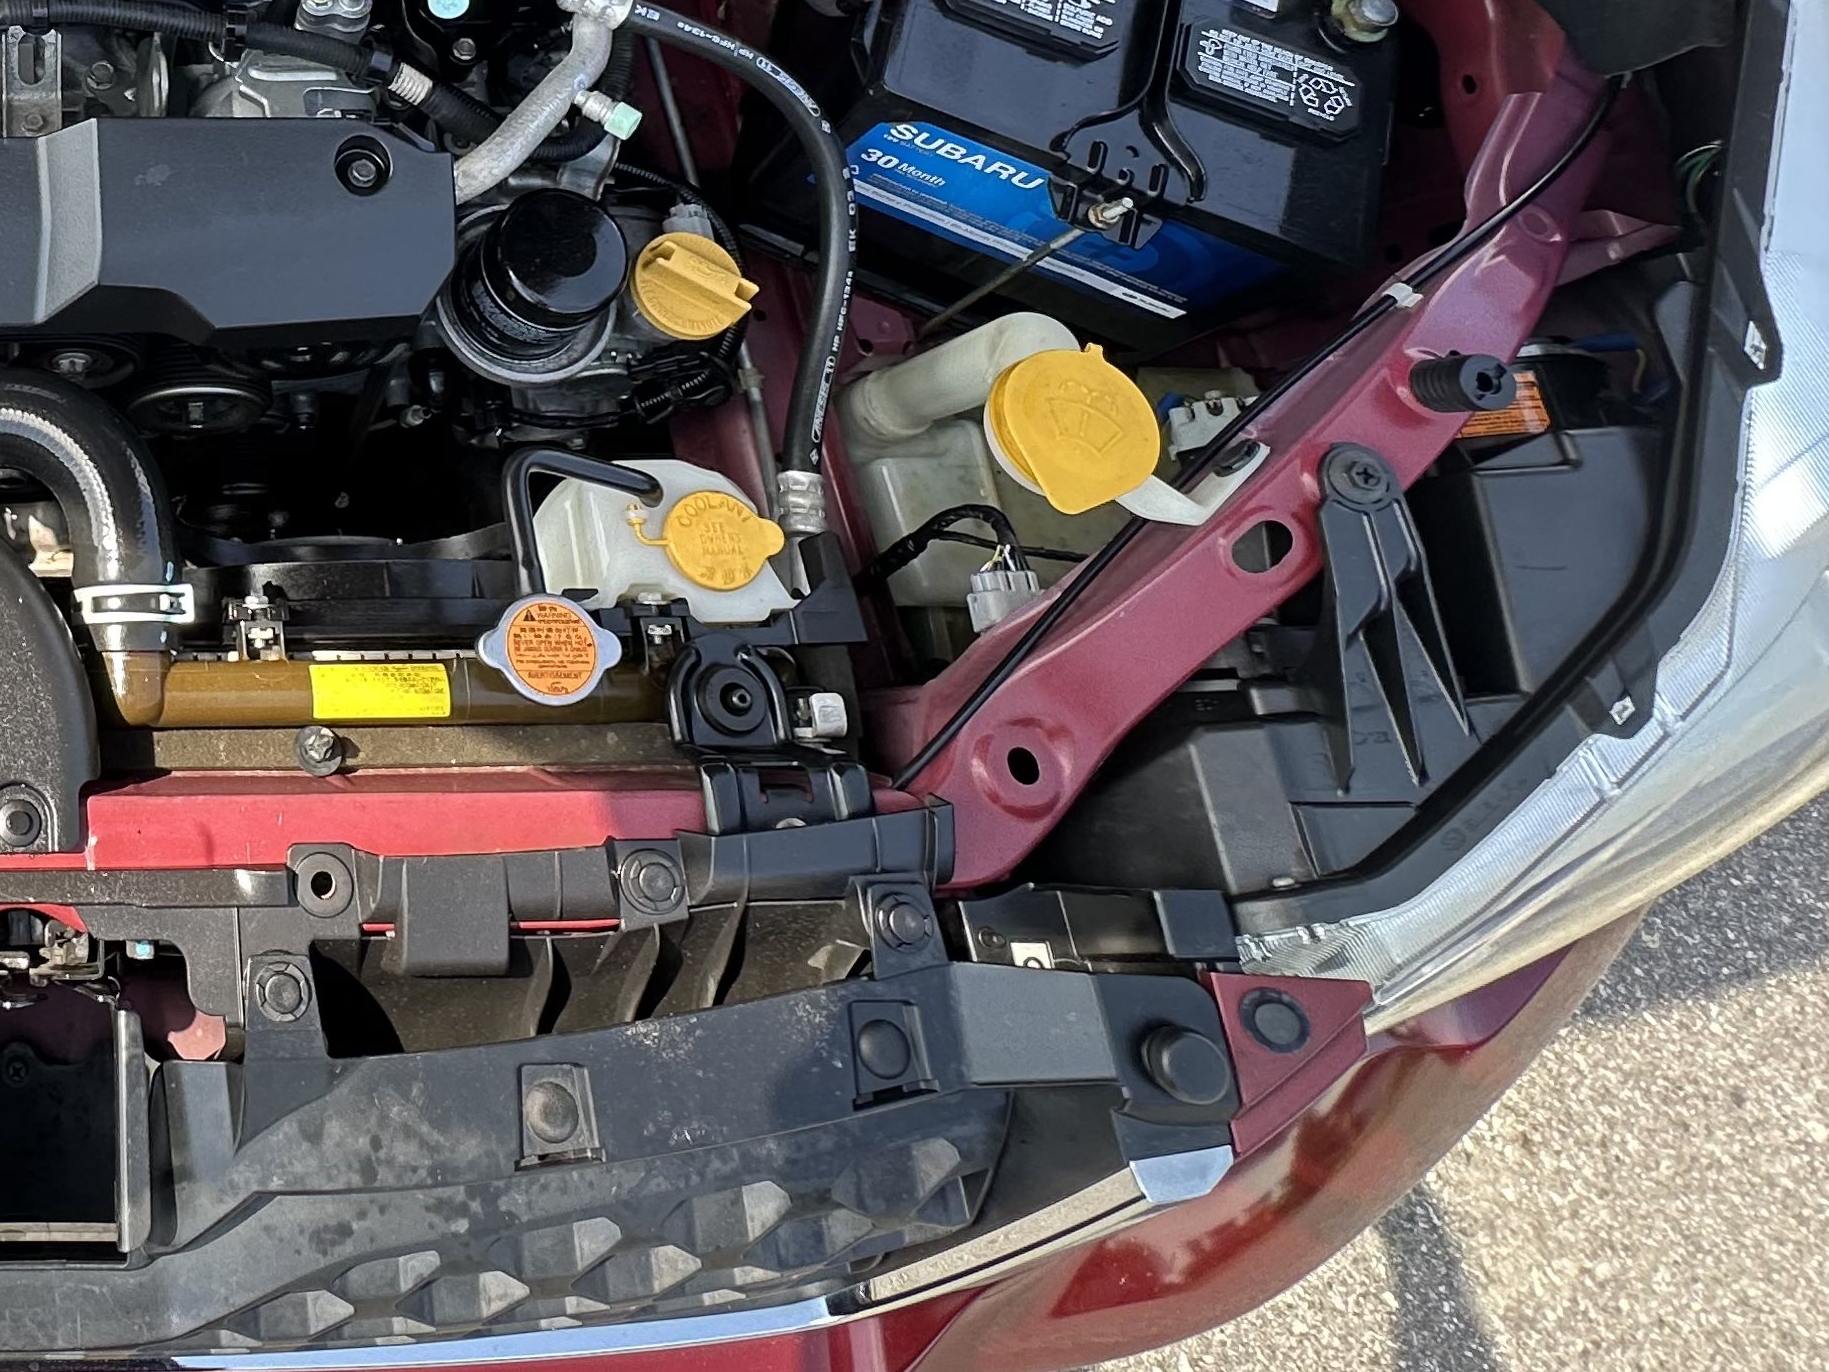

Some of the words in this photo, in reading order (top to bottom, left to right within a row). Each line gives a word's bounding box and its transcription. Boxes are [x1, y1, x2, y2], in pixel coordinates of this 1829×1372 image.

[861, 148, 899, 169] 30
[898, 162, 946, 187] Month
[890, 124, 1045, 189] SUBARU
[676, 495, 751, 527] COOLANT
[702, 545, 744, 556] MANUAL
